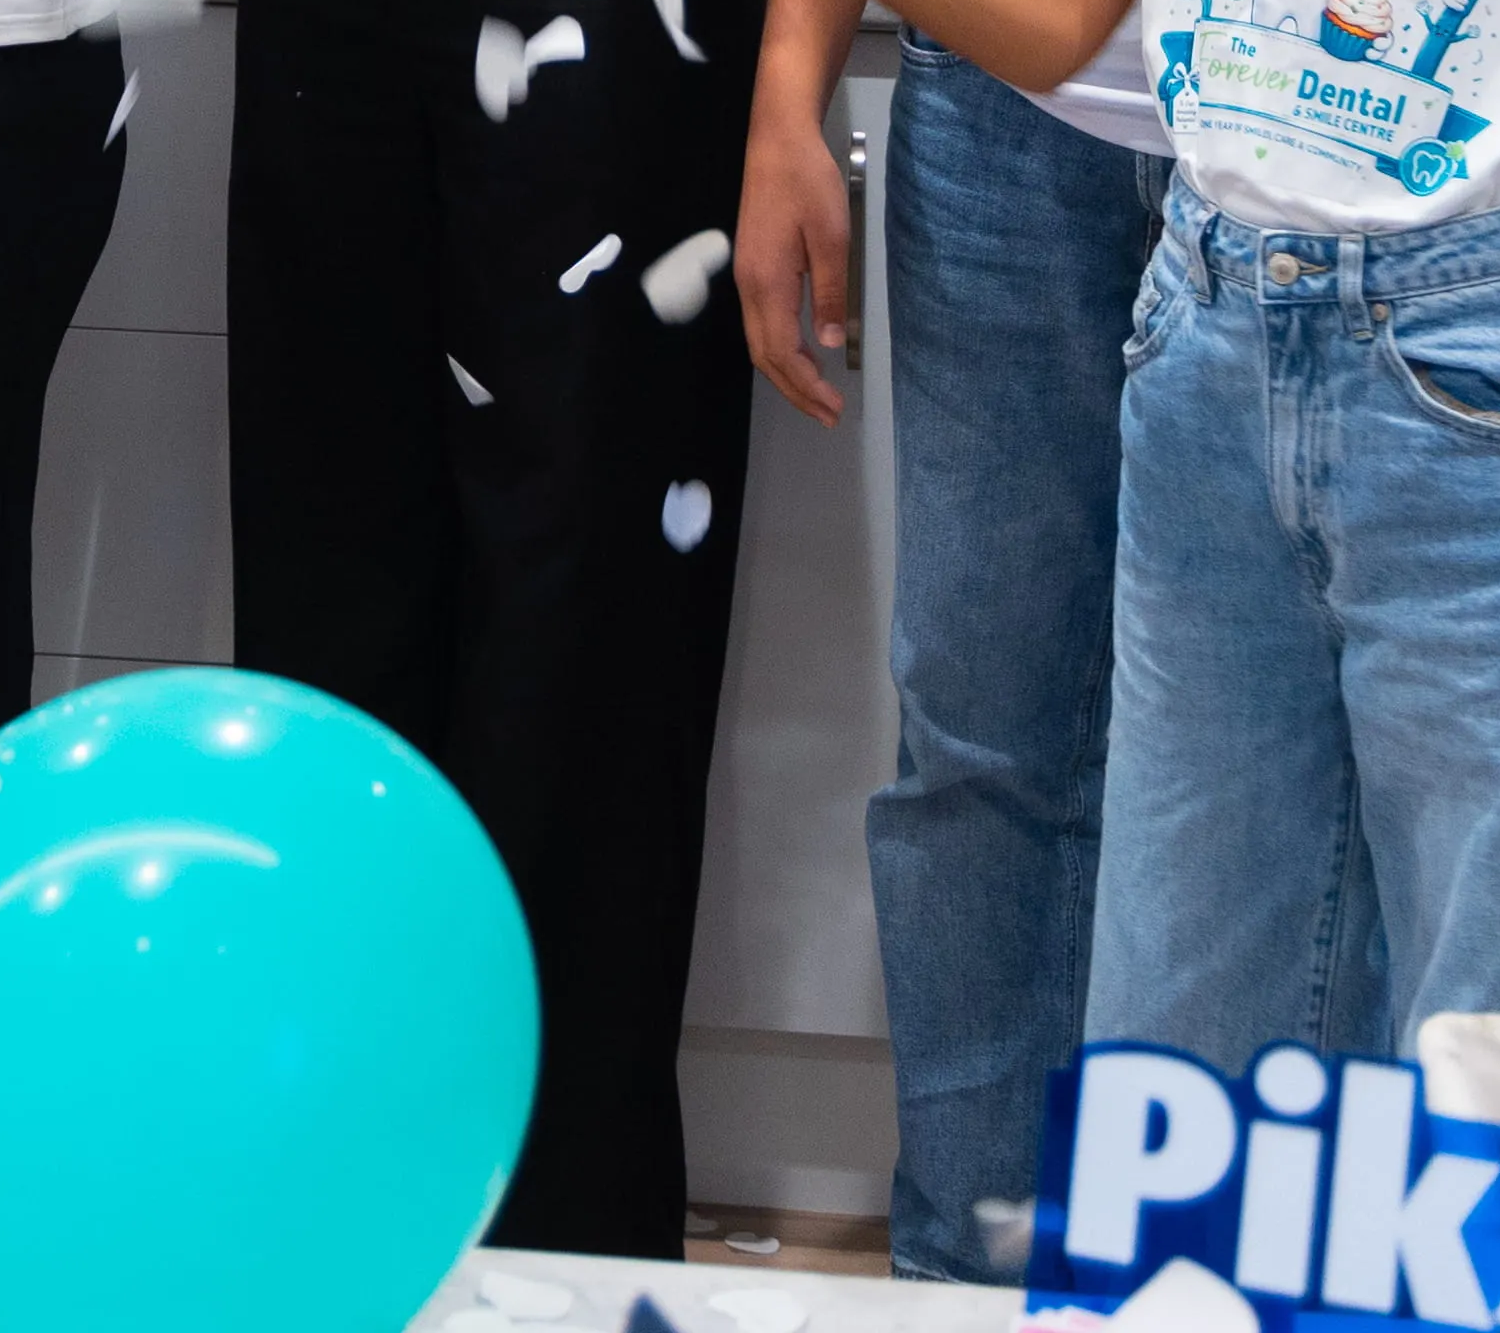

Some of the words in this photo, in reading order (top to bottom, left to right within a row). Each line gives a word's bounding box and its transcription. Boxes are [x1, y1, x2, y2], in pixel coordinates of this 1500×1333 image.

[1200, 30, 1296, 92] Forever
[1231, 37, 1257, 58] The
[1297, 69, 1407, 125] Dental
[1304, 106, 1340, 127] SMILE
[1343, 118, 1396, 144] CENTRE
[1305, 144, 1362, 172] COMMUNITY
